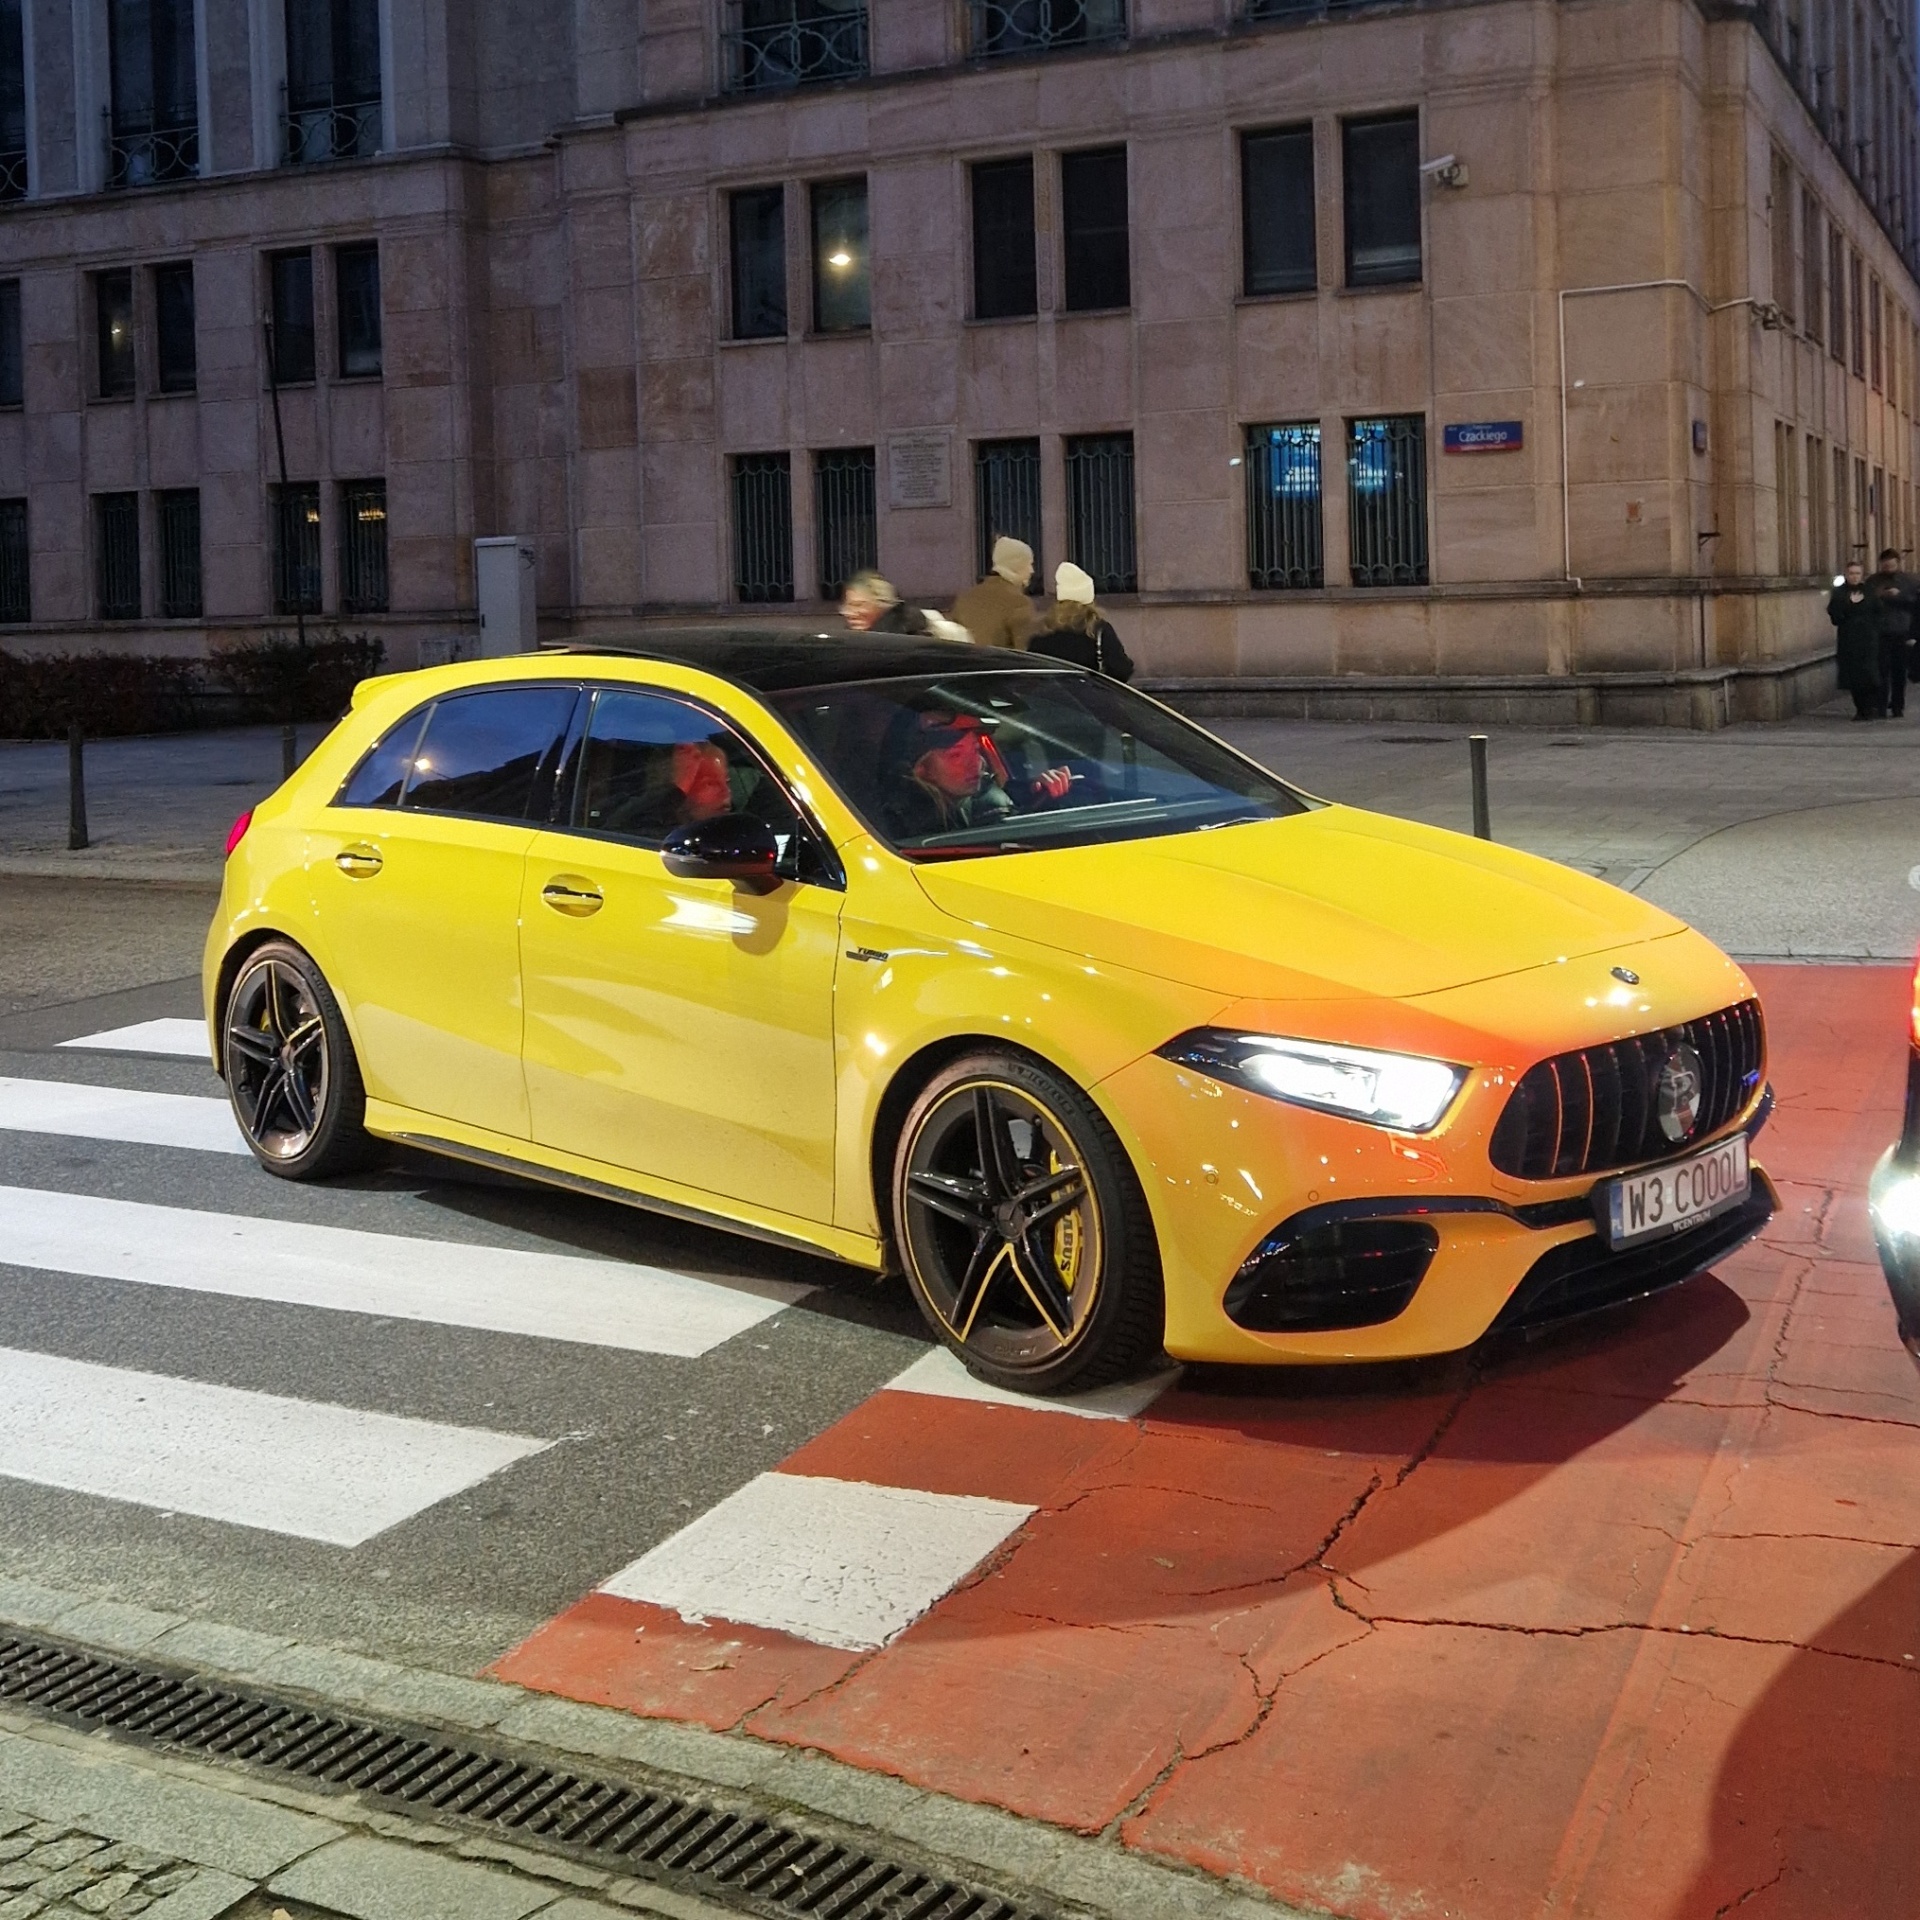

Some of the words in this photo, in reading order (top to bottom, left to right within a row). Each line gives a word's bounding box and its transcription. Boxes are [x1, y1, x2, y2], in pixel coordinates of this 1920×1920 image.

[1459, 429, 1508, 444] Czackiego
[858, 947, 889, 959] TURBO
[1629, 1177, 1664, 1230] W3
[1611, 1218, 1623, 1231] PL
